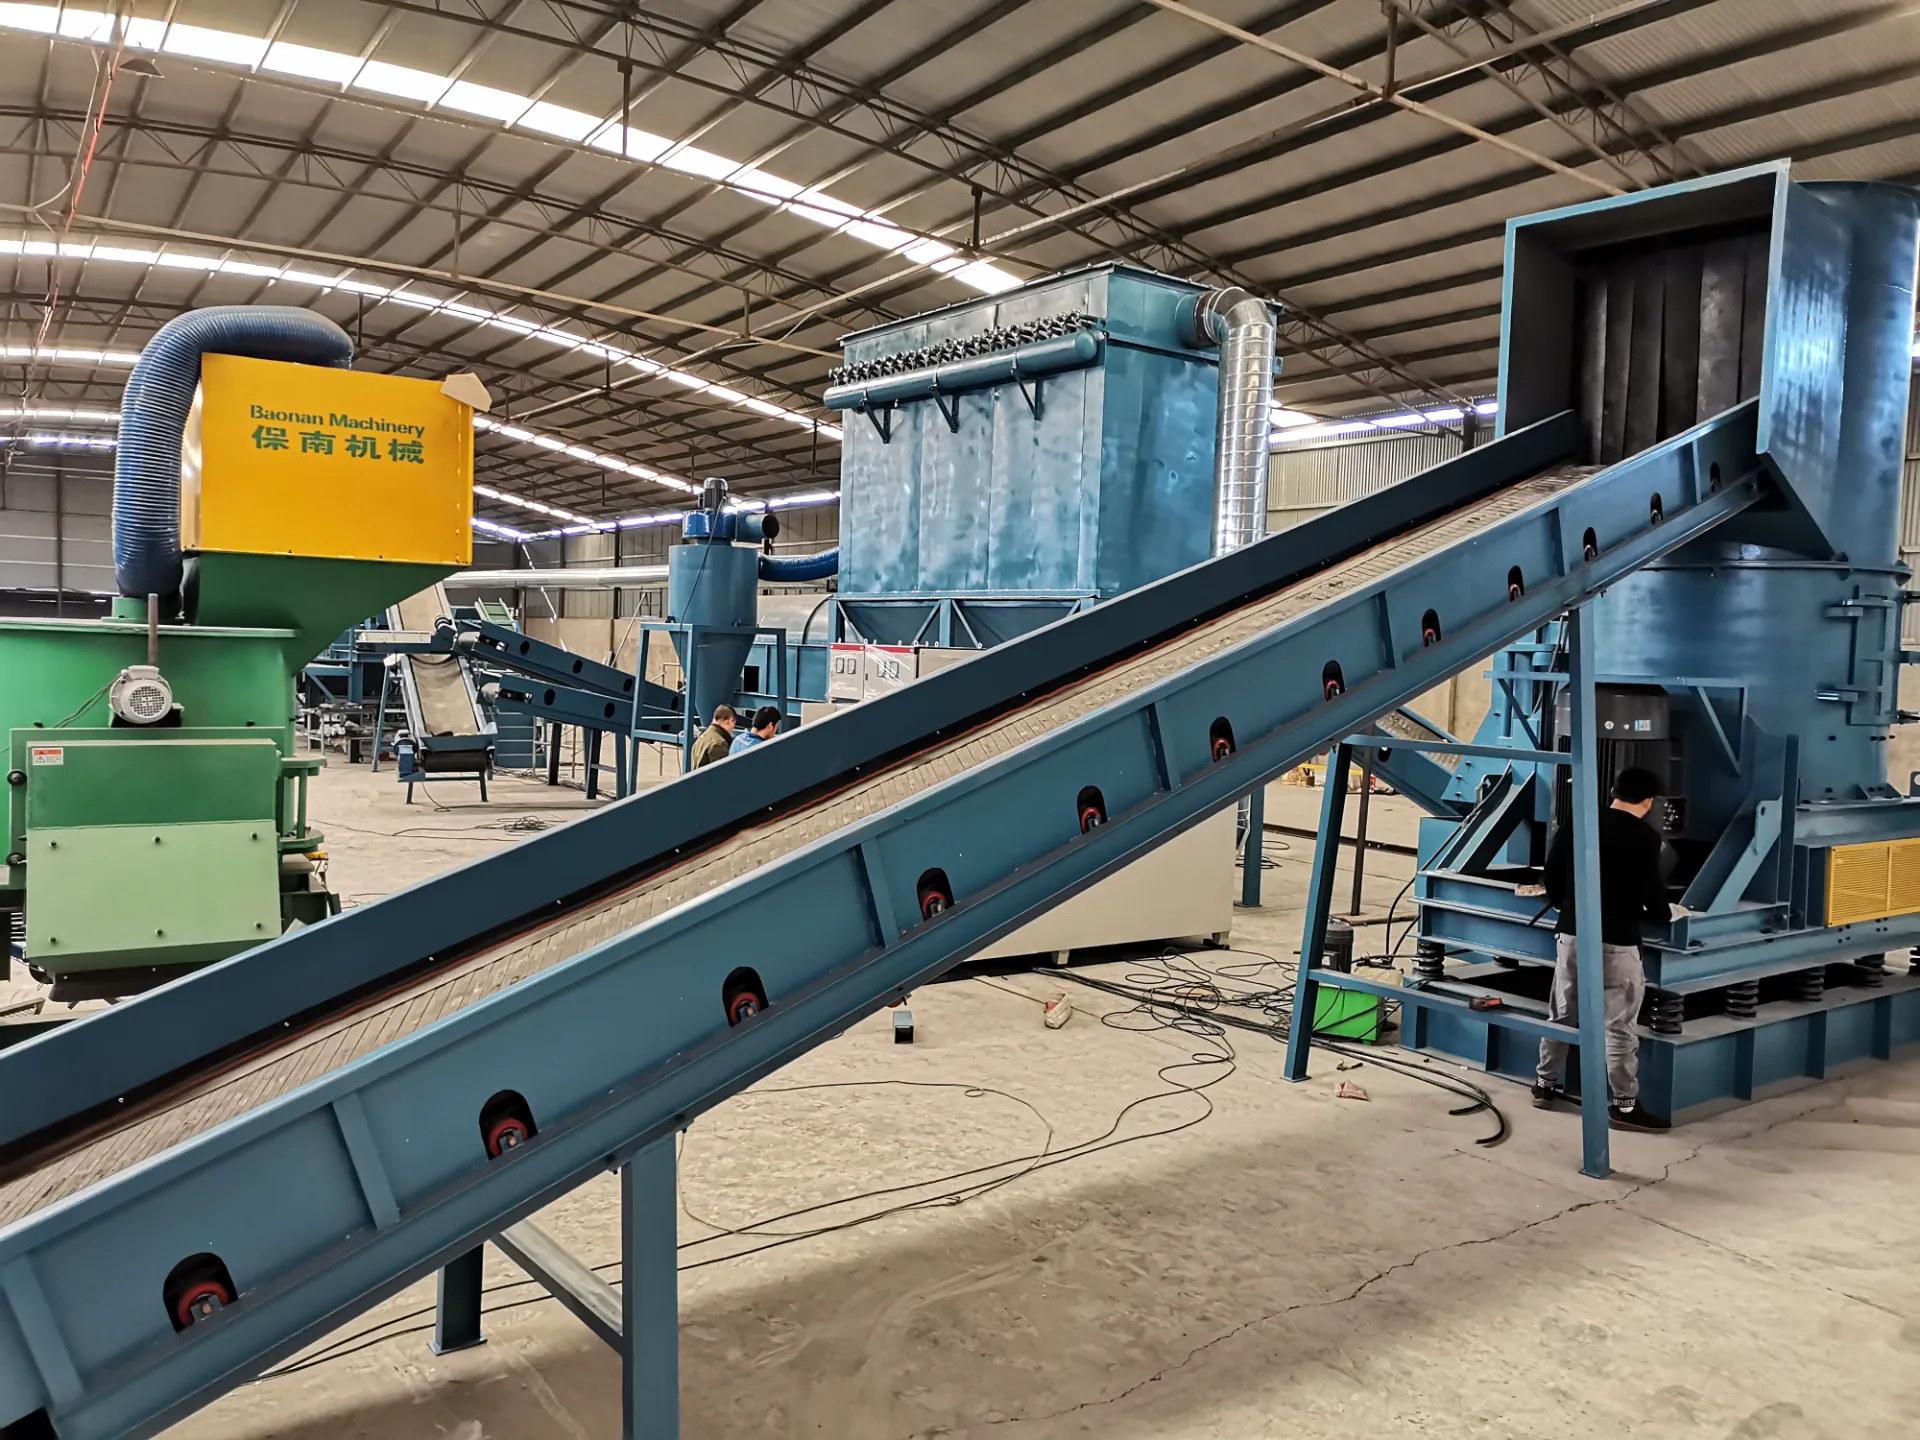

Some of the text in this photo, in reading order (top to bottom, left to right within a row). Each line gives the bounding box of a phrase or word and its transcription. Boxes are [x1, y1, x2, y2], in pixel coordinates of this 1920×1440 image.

[251, 405, 425, 438] Baonan Machinery
[251, 425, 424, 464] 保南机械
